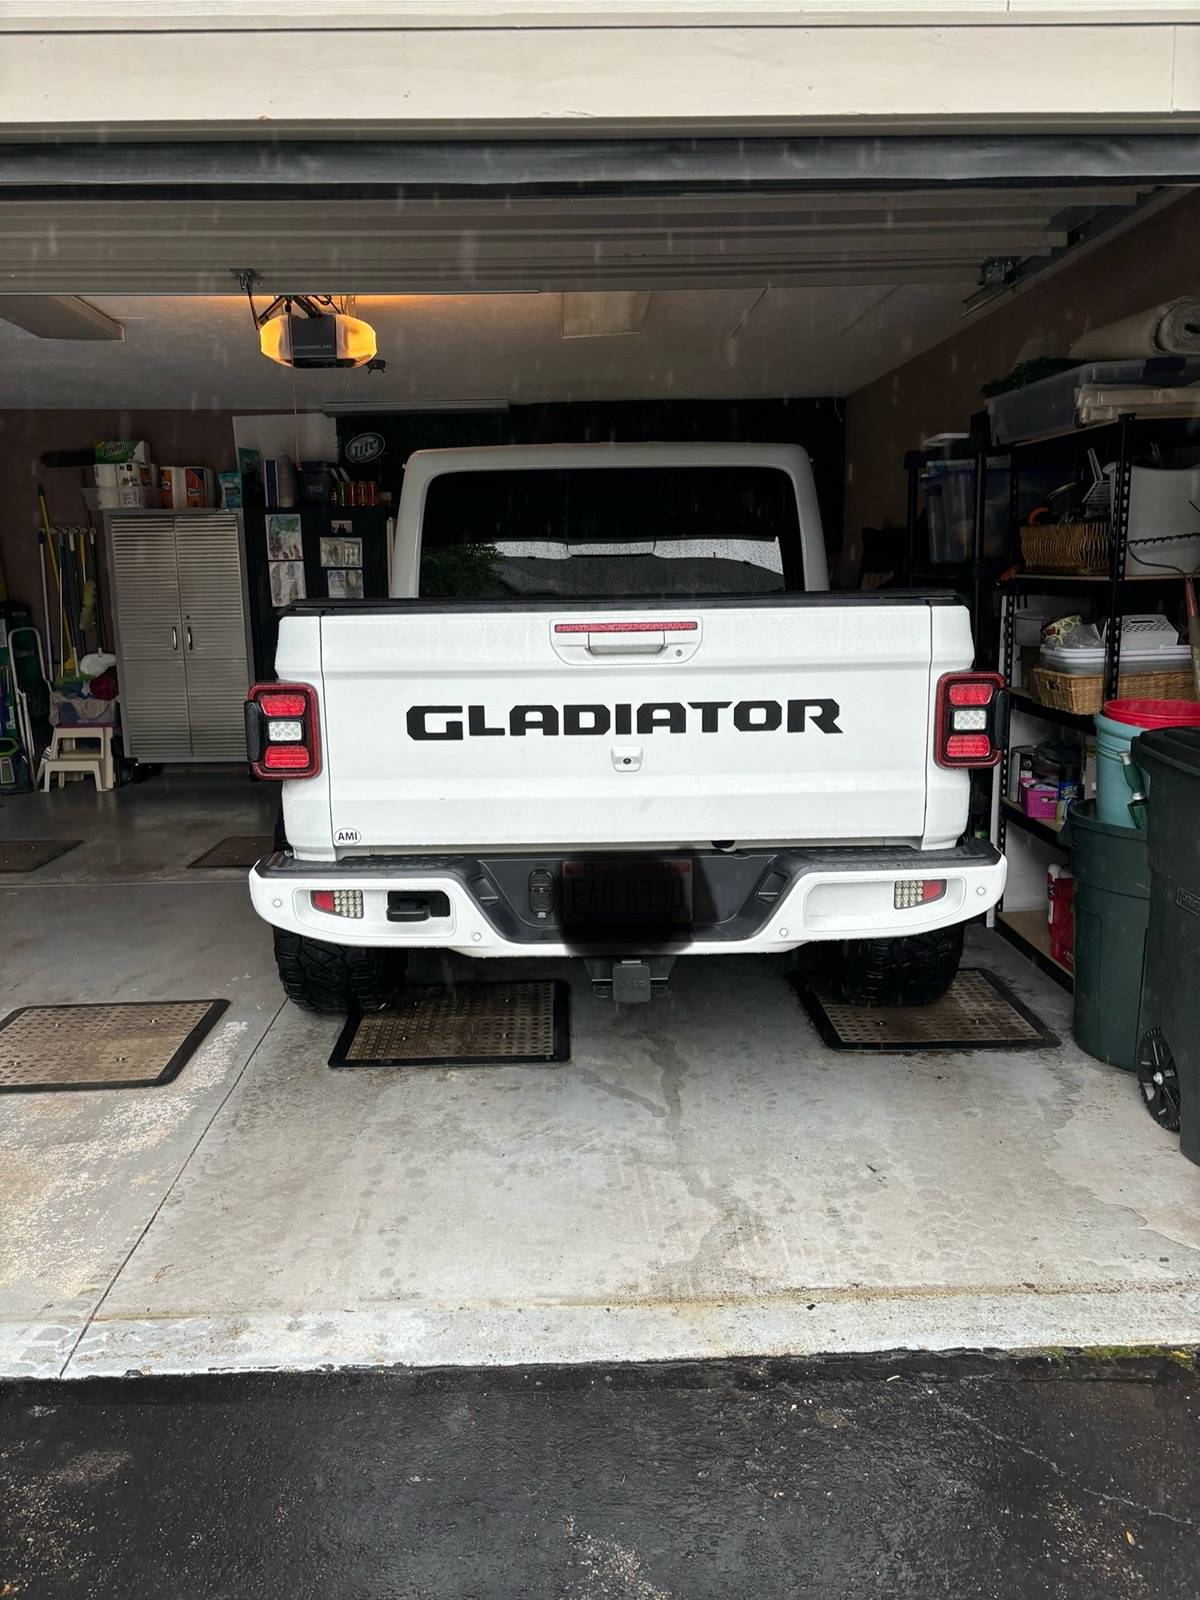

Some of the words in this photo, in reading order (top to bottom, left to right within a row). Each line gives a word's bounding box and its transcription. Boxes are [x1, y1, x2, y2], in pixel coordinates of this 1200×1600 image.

[103, 443, 127, 456] Bounty
[406, 699, 843, 740] GLADIATOR
[338, 832, 358, 841] AMI
